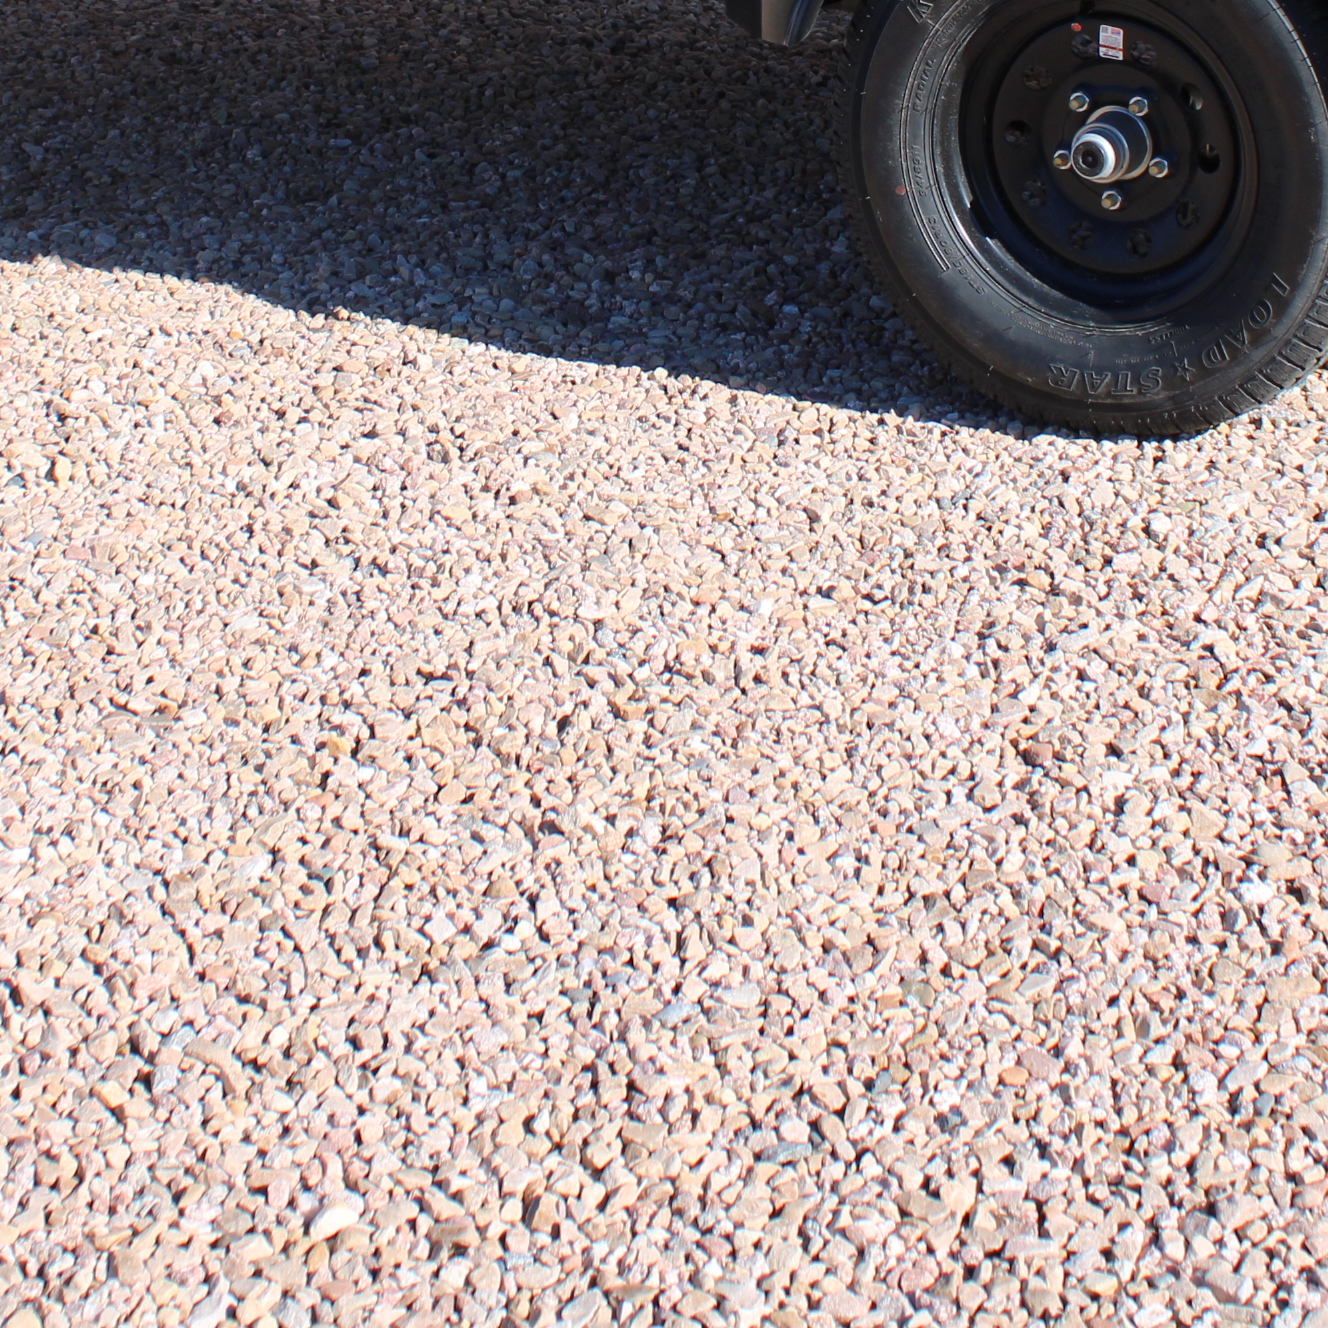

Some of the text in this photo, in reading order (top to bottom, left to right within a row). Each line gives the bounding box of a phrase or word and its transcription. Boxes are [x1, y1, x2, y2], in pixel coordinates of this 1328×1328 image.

[912, 58, 937, 113] RADIAL
[1201, 272, 1291, 369] LOAD
[1048, 362, 1163, 395] STAR
